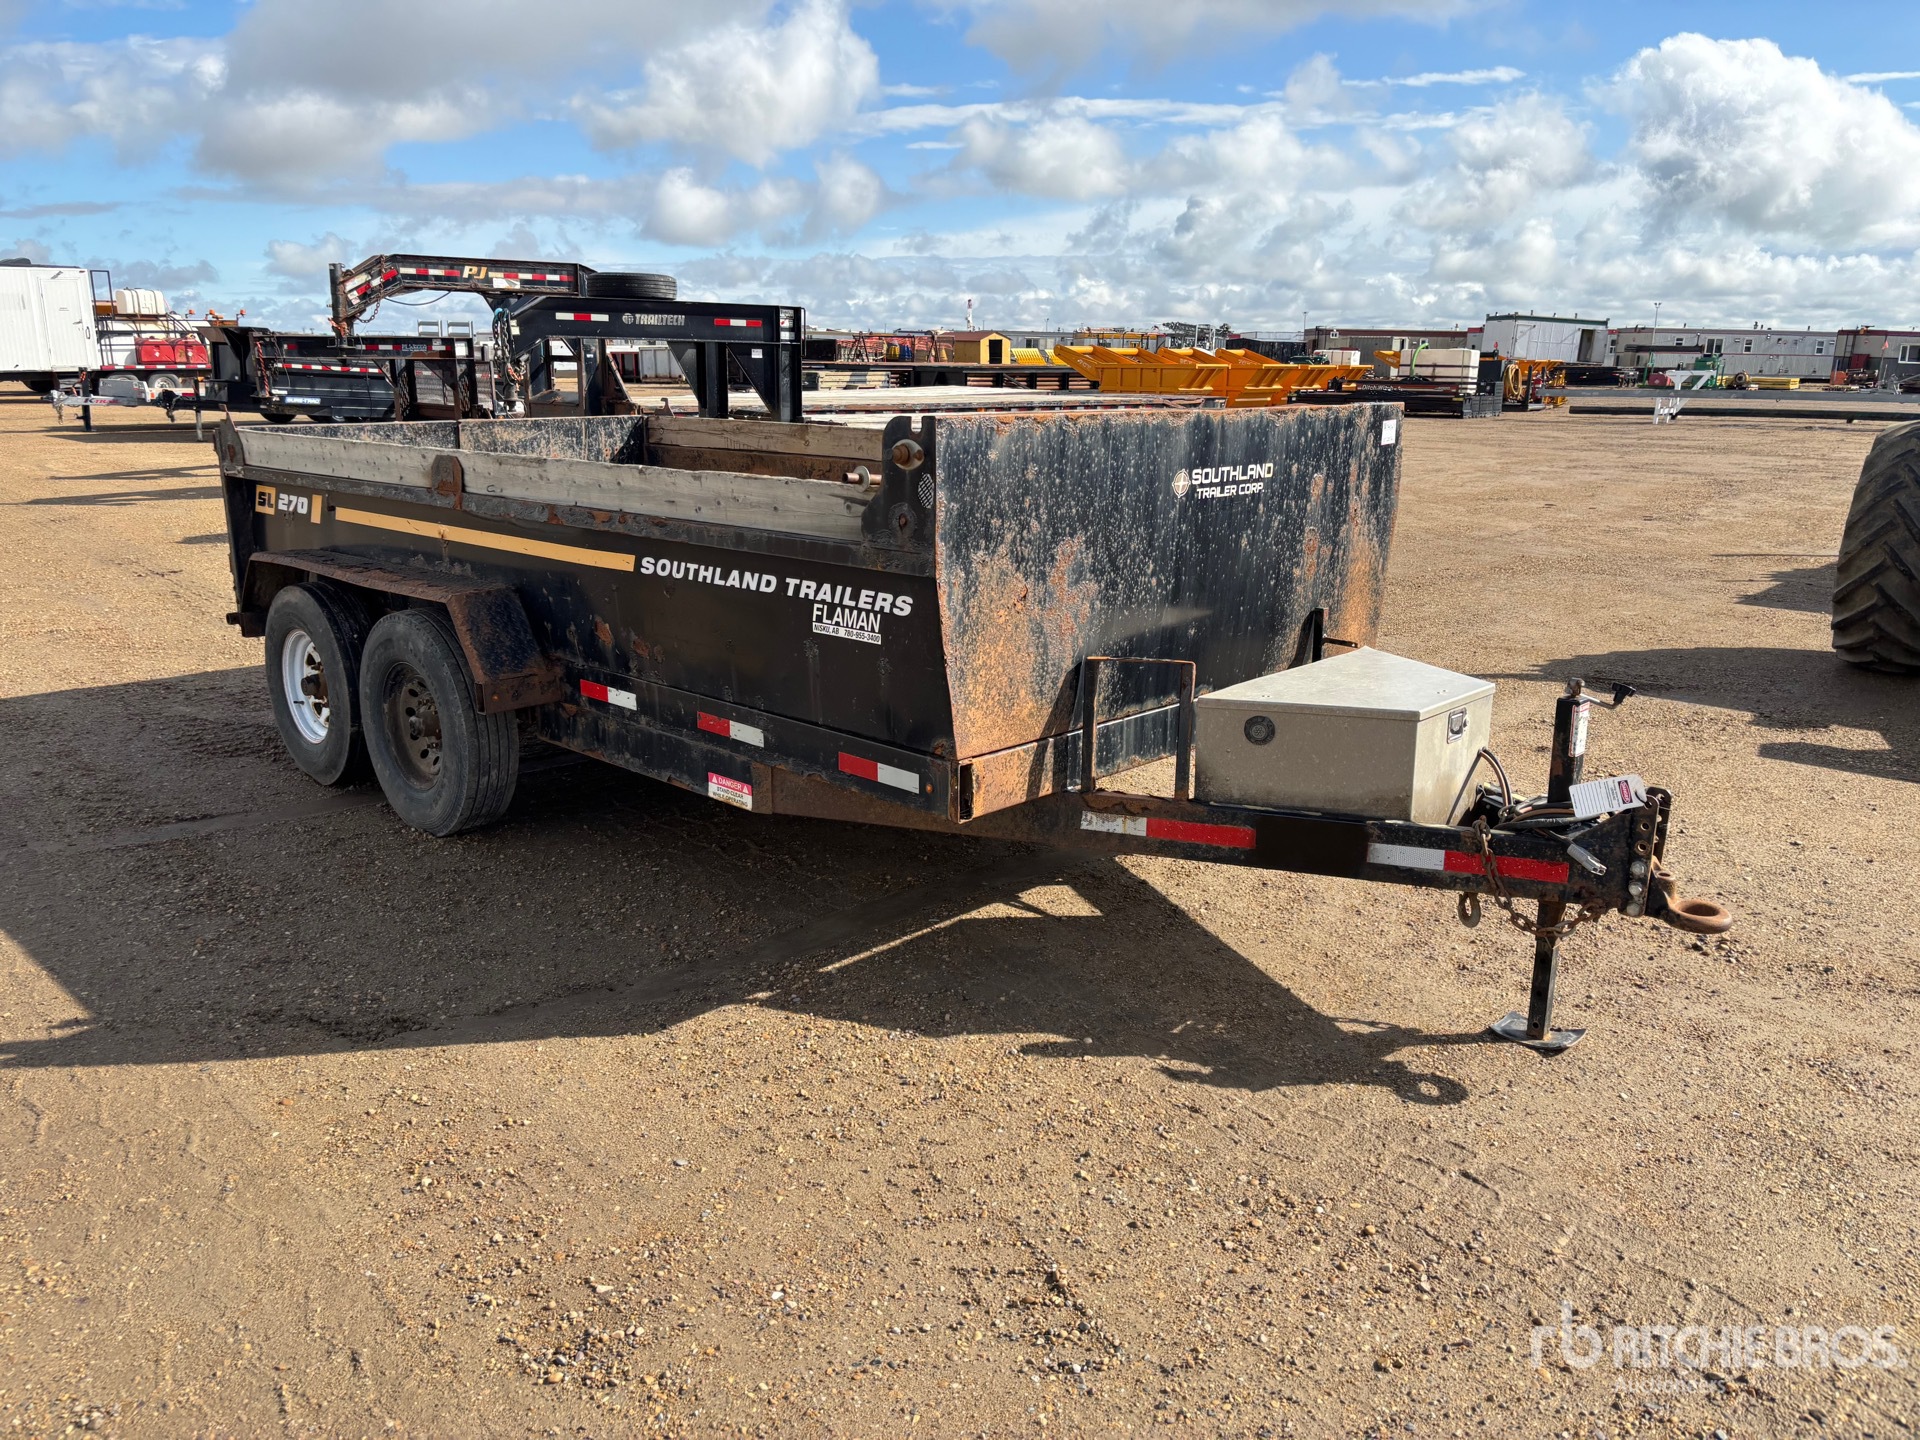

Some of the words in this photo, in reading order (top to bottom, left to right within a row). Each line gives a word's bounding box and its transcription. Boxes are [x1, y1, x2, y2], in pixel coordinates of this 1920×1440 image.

[462, 265, 488, 280] PJ
[634, 313, 686, 326] TRAILTECH
[1191, 463, 1274, 485] SOUTHLAND
[1196, 484, 1238, 499] TRAILER
[1238, 482, 1265, 495] CORP.
[257, 491, 275, 508] SL
[277, 493, 309, 515] 270
[640, 556, 777, 593] SOUTHLAND
[785, 577, 914, 617] TRAILERS
[812, 603, 881, 633] FLAMAN
[813, 624, 831, 634] NISKU,
[718, 776, 742, 791] DANGER
[1620, 780, 1631, 804] DANGER
[716, 786, 730, 795] STAND
[730, 790, 744, 799] CLEAR
